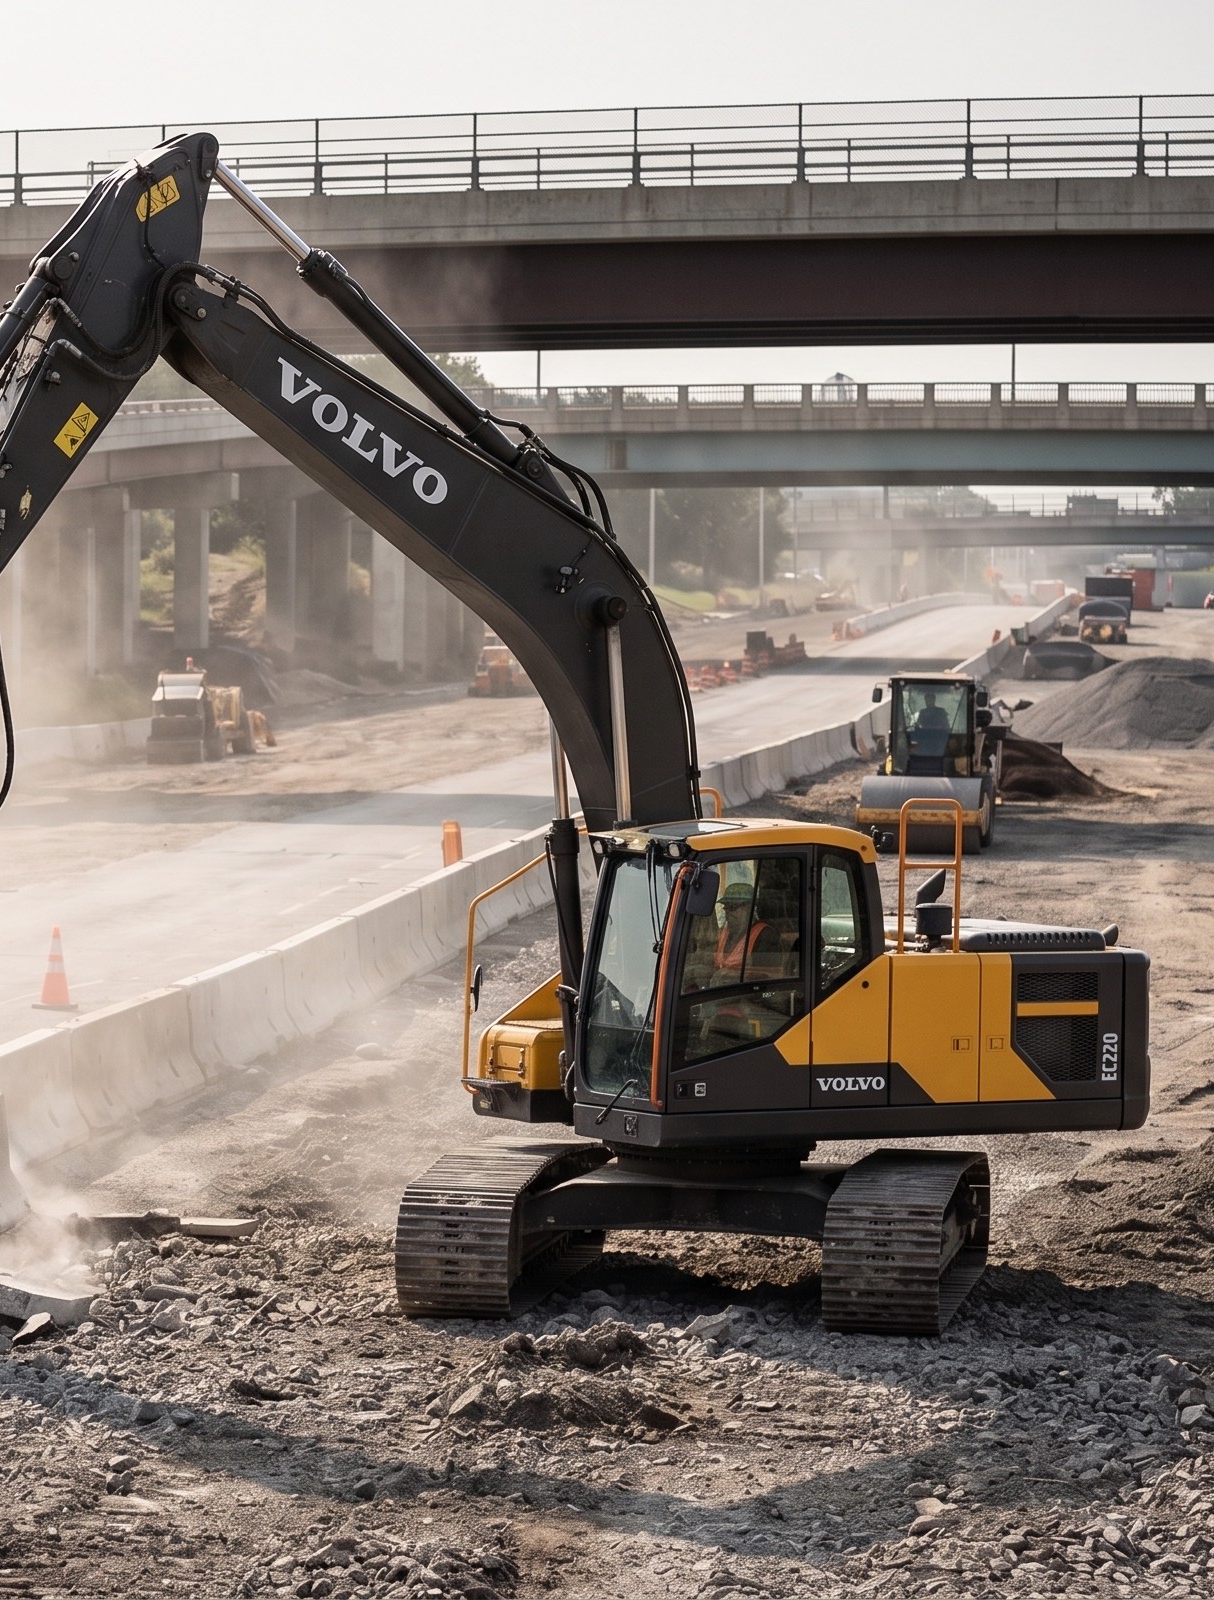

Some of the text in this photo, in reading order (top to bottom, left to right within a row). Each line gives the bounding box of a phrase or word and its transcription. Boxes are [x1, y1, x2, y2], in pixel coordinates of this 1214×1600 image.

[277, 356, 448, 504] VOLVO
[1101, 1033, 1118, 1081] EC220
[816, 1076, 886, 1091] VOLVO
